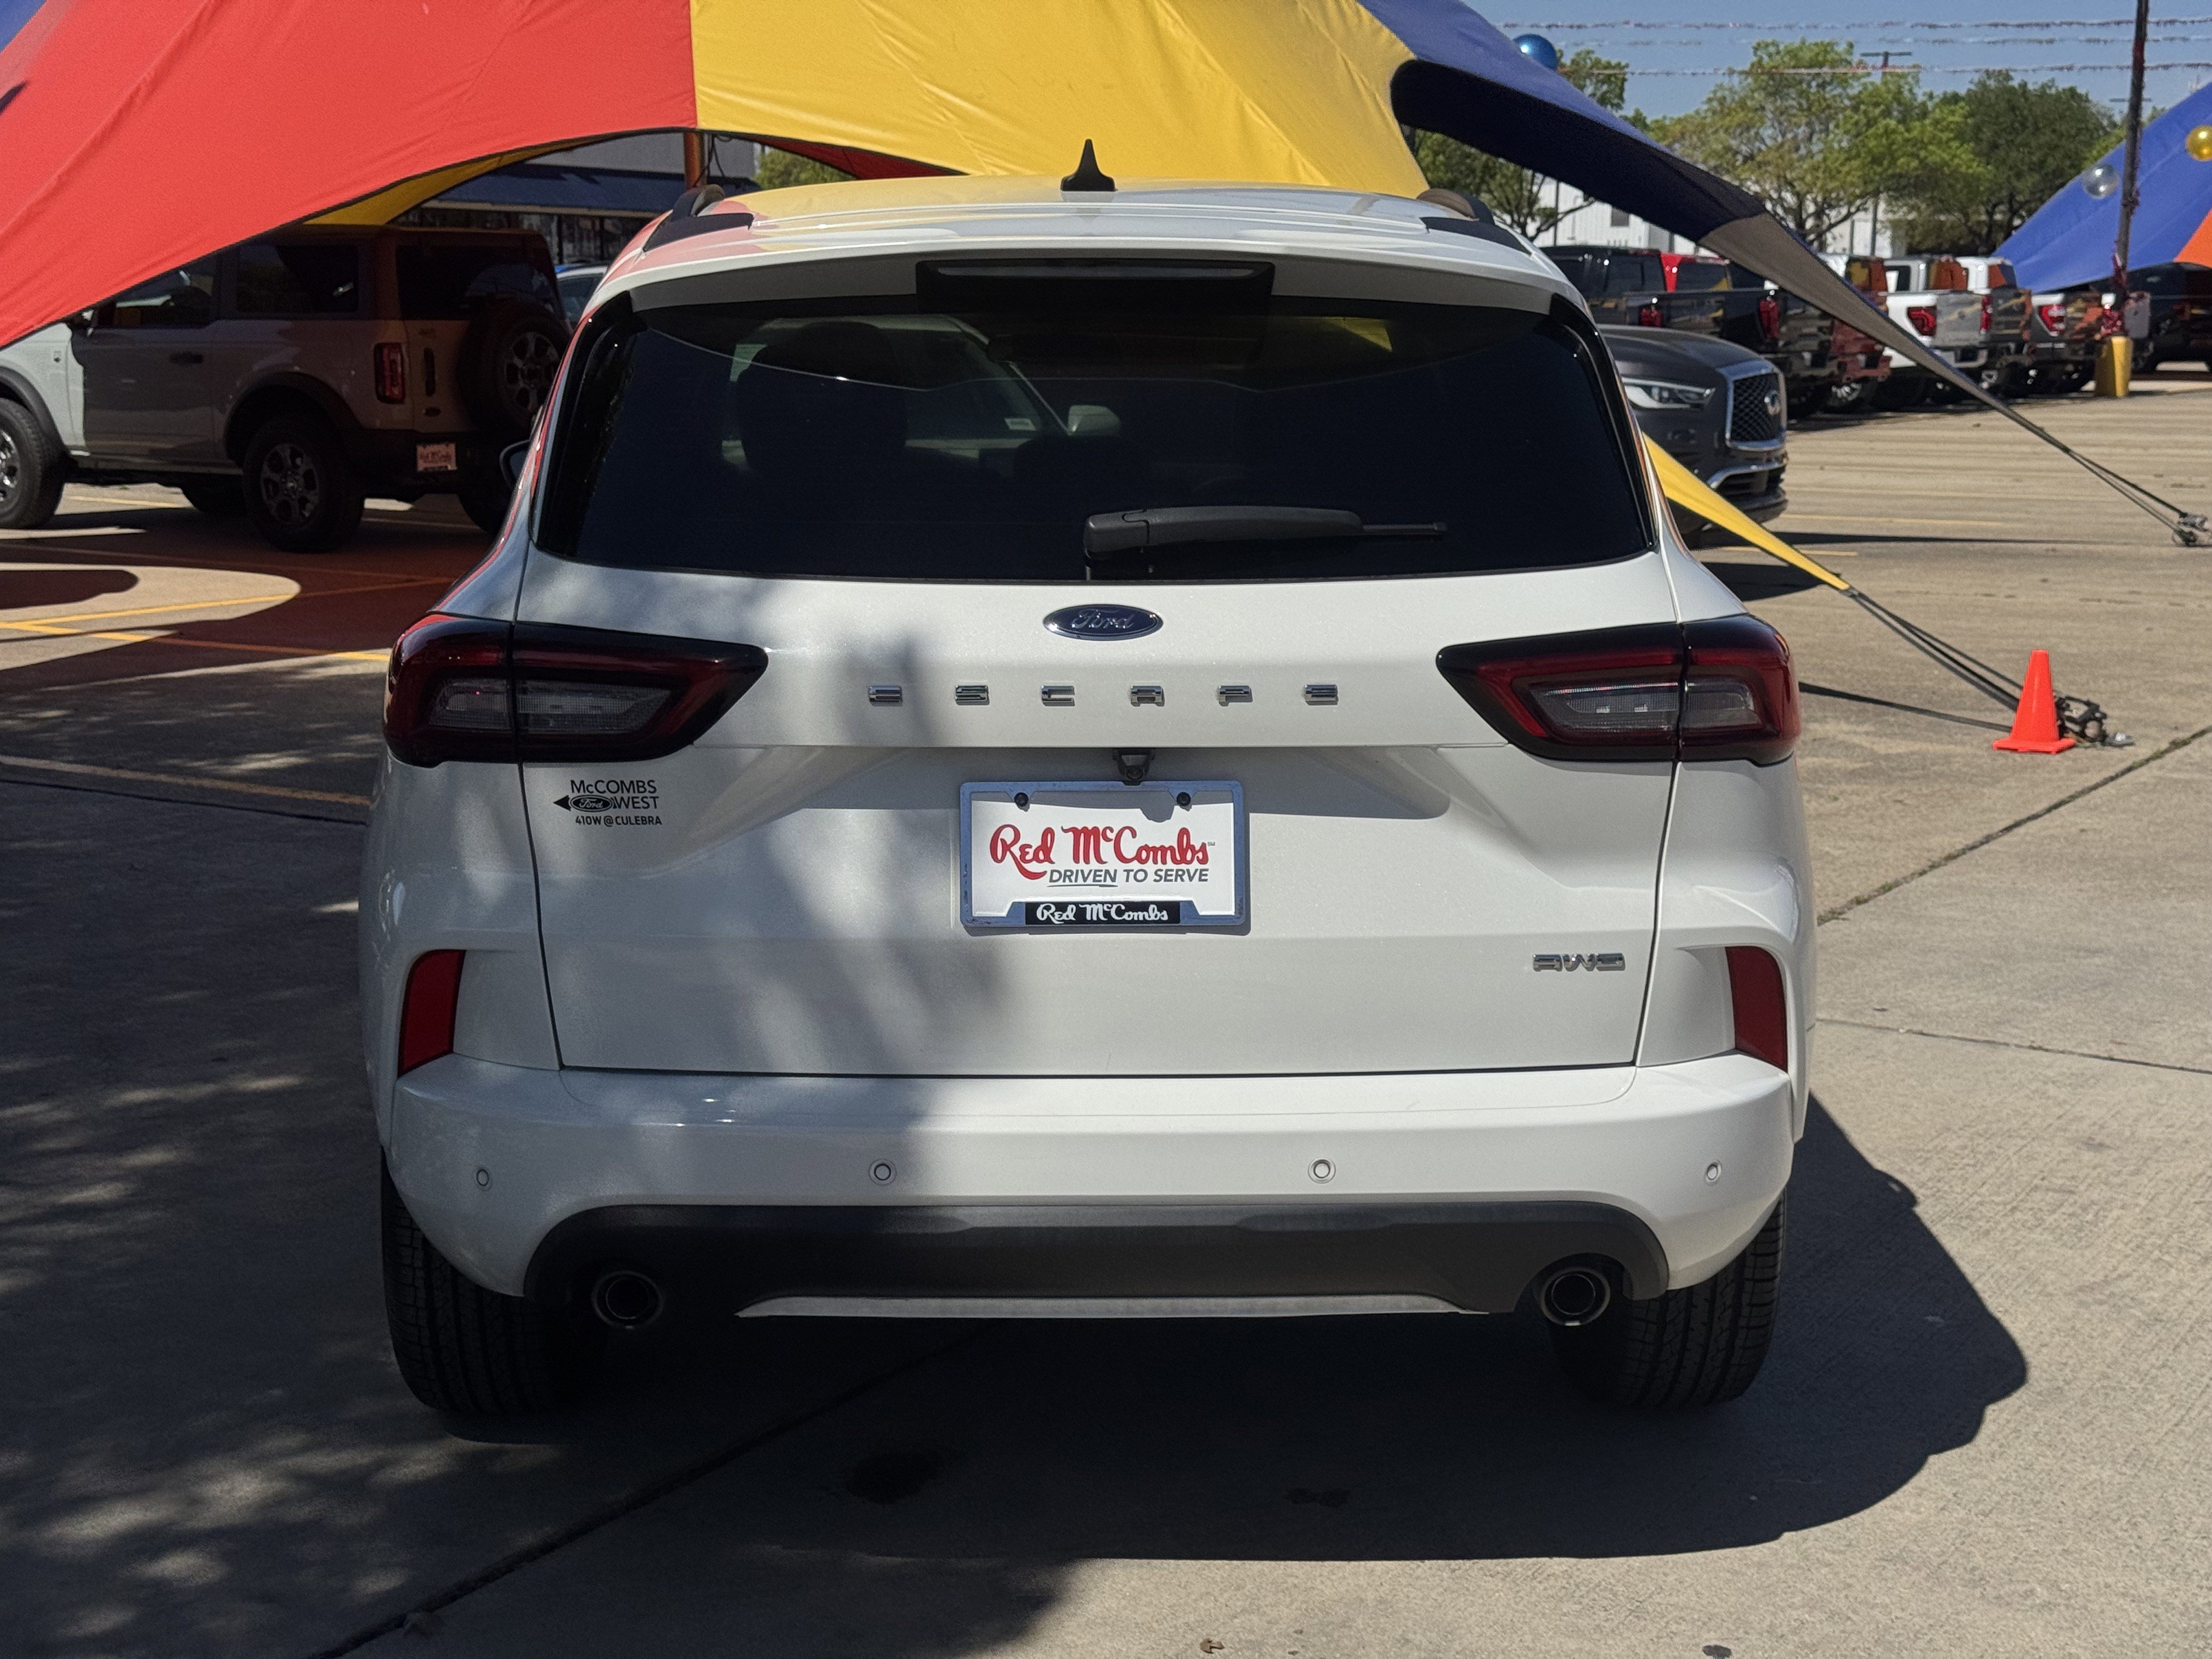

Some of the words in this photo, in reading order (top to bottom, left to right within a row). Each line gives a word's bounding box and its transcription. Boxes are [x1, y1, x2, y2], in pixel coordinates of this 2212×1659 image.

[1071, 608, 1135, 629] Ford
[869, 684, 1337, 706] ESCAPE
[570, 780, 657, 794] McCOMBS
[579, 799, 604, 809] Ford
[613, 796, 659, 809] WEST
[990, 824, 1055, 880] Red
[1061, 826, 1209, 865] McCombs
[1048, 868, 1118, 883] DRIVEN
[1123, 868, 1148, 883] TO
[1153, 868, 1210, 883] SERVE
[1036, 903, 1076, 924] Red
[1079, 904, 1169, 921] McCombs
[1532, 953, 1626, 972] AWD
